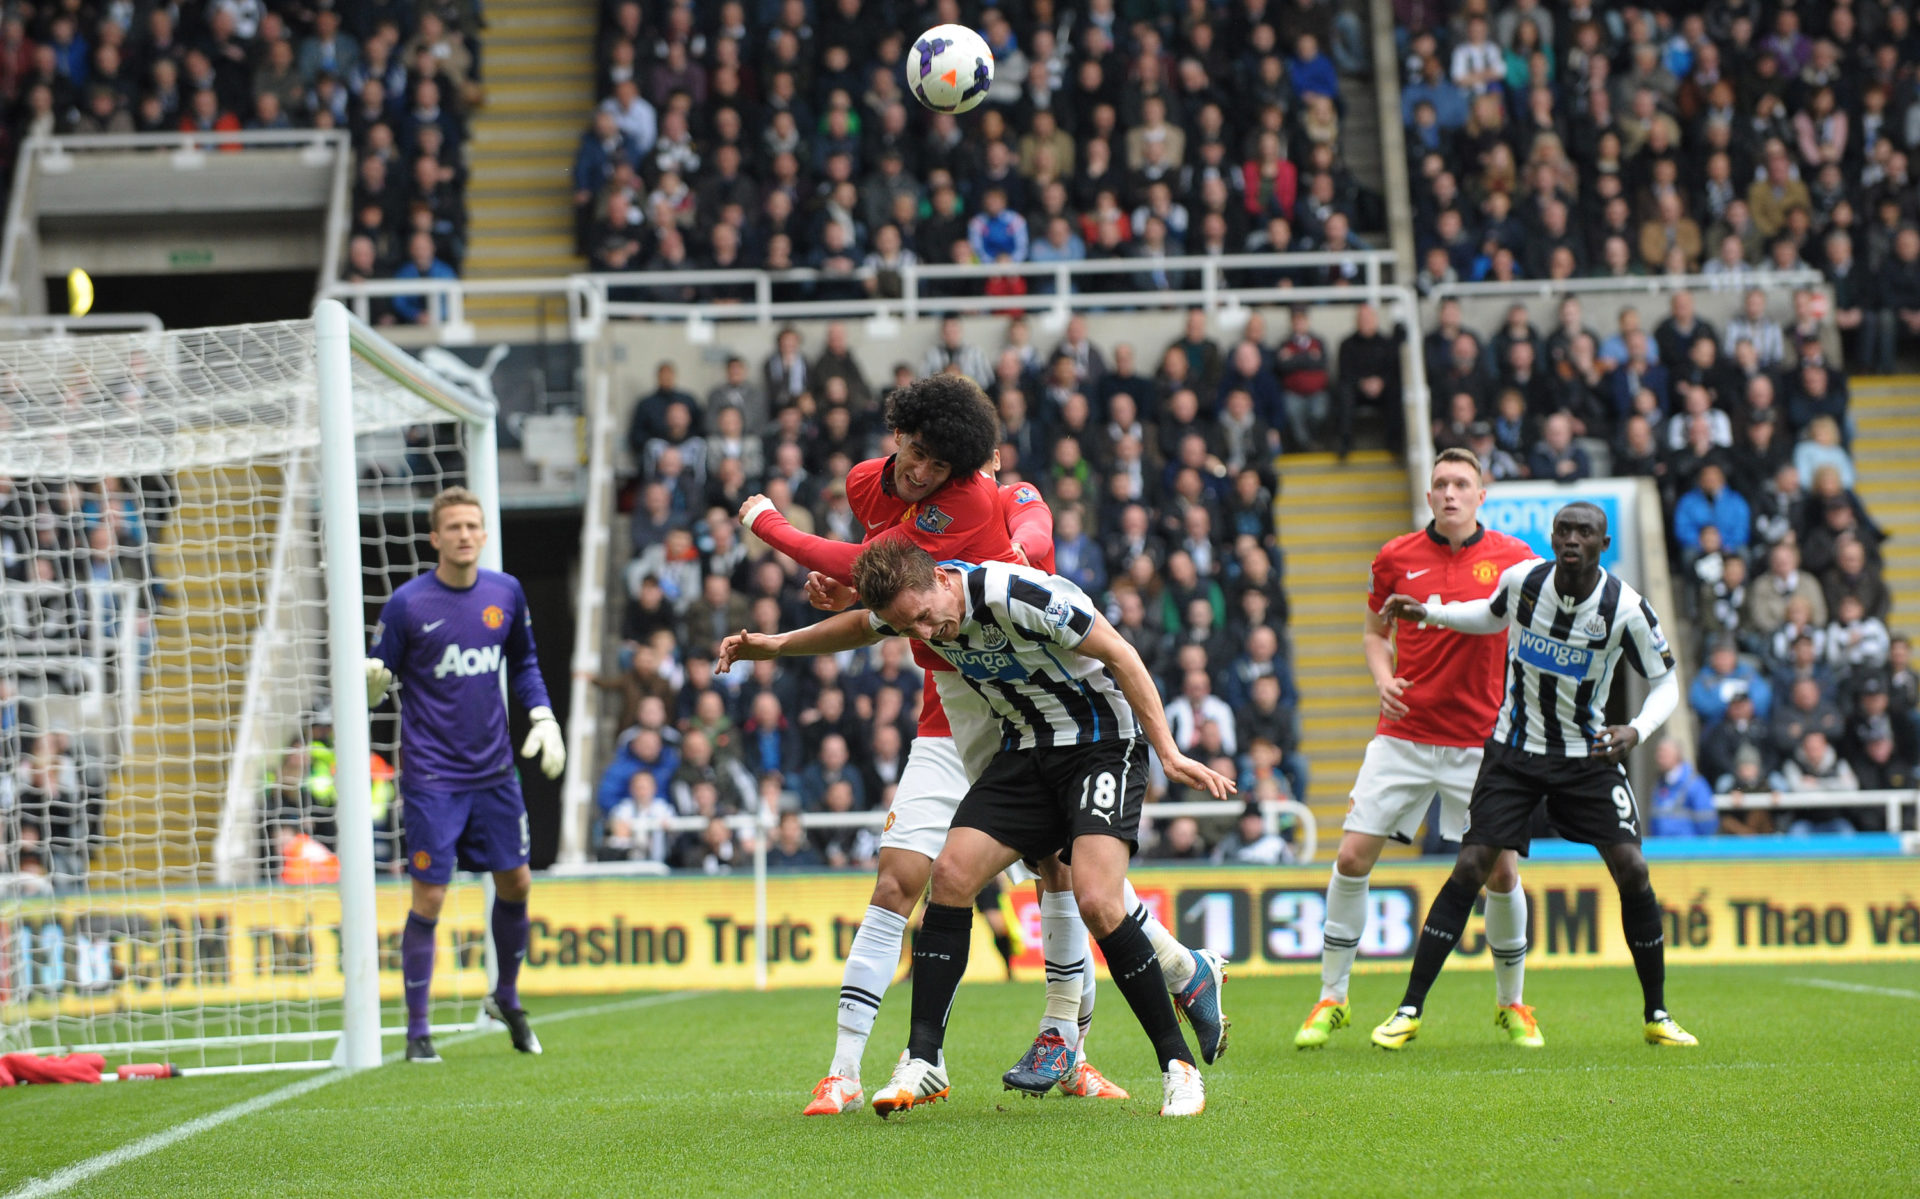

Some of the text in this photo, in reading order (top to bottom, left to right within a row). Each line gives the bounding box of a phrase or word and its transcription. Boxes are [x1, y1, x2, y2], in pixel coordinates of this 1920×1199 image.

[1522, 630, 1582, 667] wonga
[1080, 771, 1117, 810] 18
[1611, 785, 1632, 820] 9
[526, 914, 687, 967] Casino
[1184, 889, 1413, 959] 138
[1727, 899, 1849, 946] Thao
